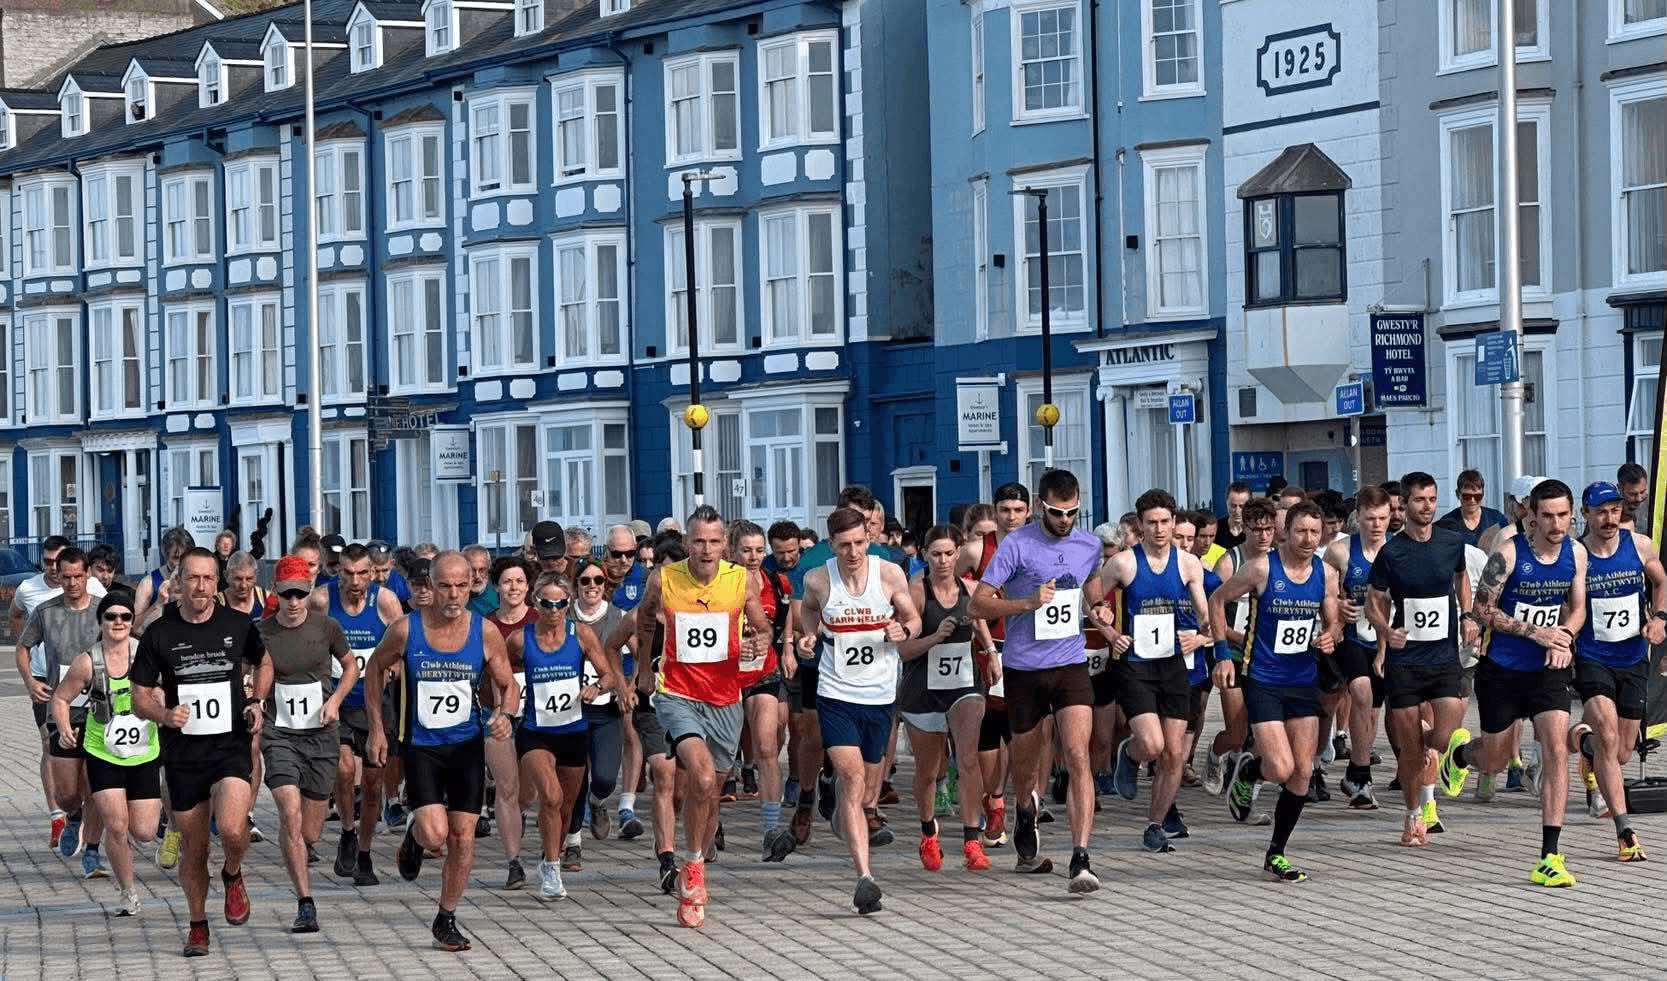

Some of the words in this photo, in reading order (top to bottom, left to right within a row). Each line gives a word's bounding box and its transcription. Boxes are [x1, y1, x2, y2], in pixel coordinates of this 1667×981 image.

[1275, 42, 1325, 78] 1925
[1376, 319, 1419, 330] GWESTY'R
[1375, 333, 1422, 346] RICHMOND
[1106, 344, 1175, 365] ATLANTIC
[1385, 349, 1413, 360] HOTEL
[1176, 409, 1187, 419] OUT
[1344, 399, 1356, 410] OUT
[963, 411, 998, 421] MARINE
[440, 451, 468, 460] MARINE
[191, 515, 220, 523] MARINE
[844, 607, 872, 616] CLWB
[1046, 604, 1071, 625] 95
[1414, 611, 1440, 628] 92
[1520, 608, 1558, 627] 105
[1603, 610, 1629, 629] 73
[687, 628, 717, 648] 89
[1151, 627, 1159, 645] 1
[1282, 627, 1307, 645] 88
[846, 645, 874, 666] 28
[939, 656, 963, 676] 57
[191, 698, 220, 719] 10
[286, 697, 308, 716] 11
[429, 694, 460, 715] 79
[545, 693, 571, 713] 42
[114, 727, 140, 746] 29
